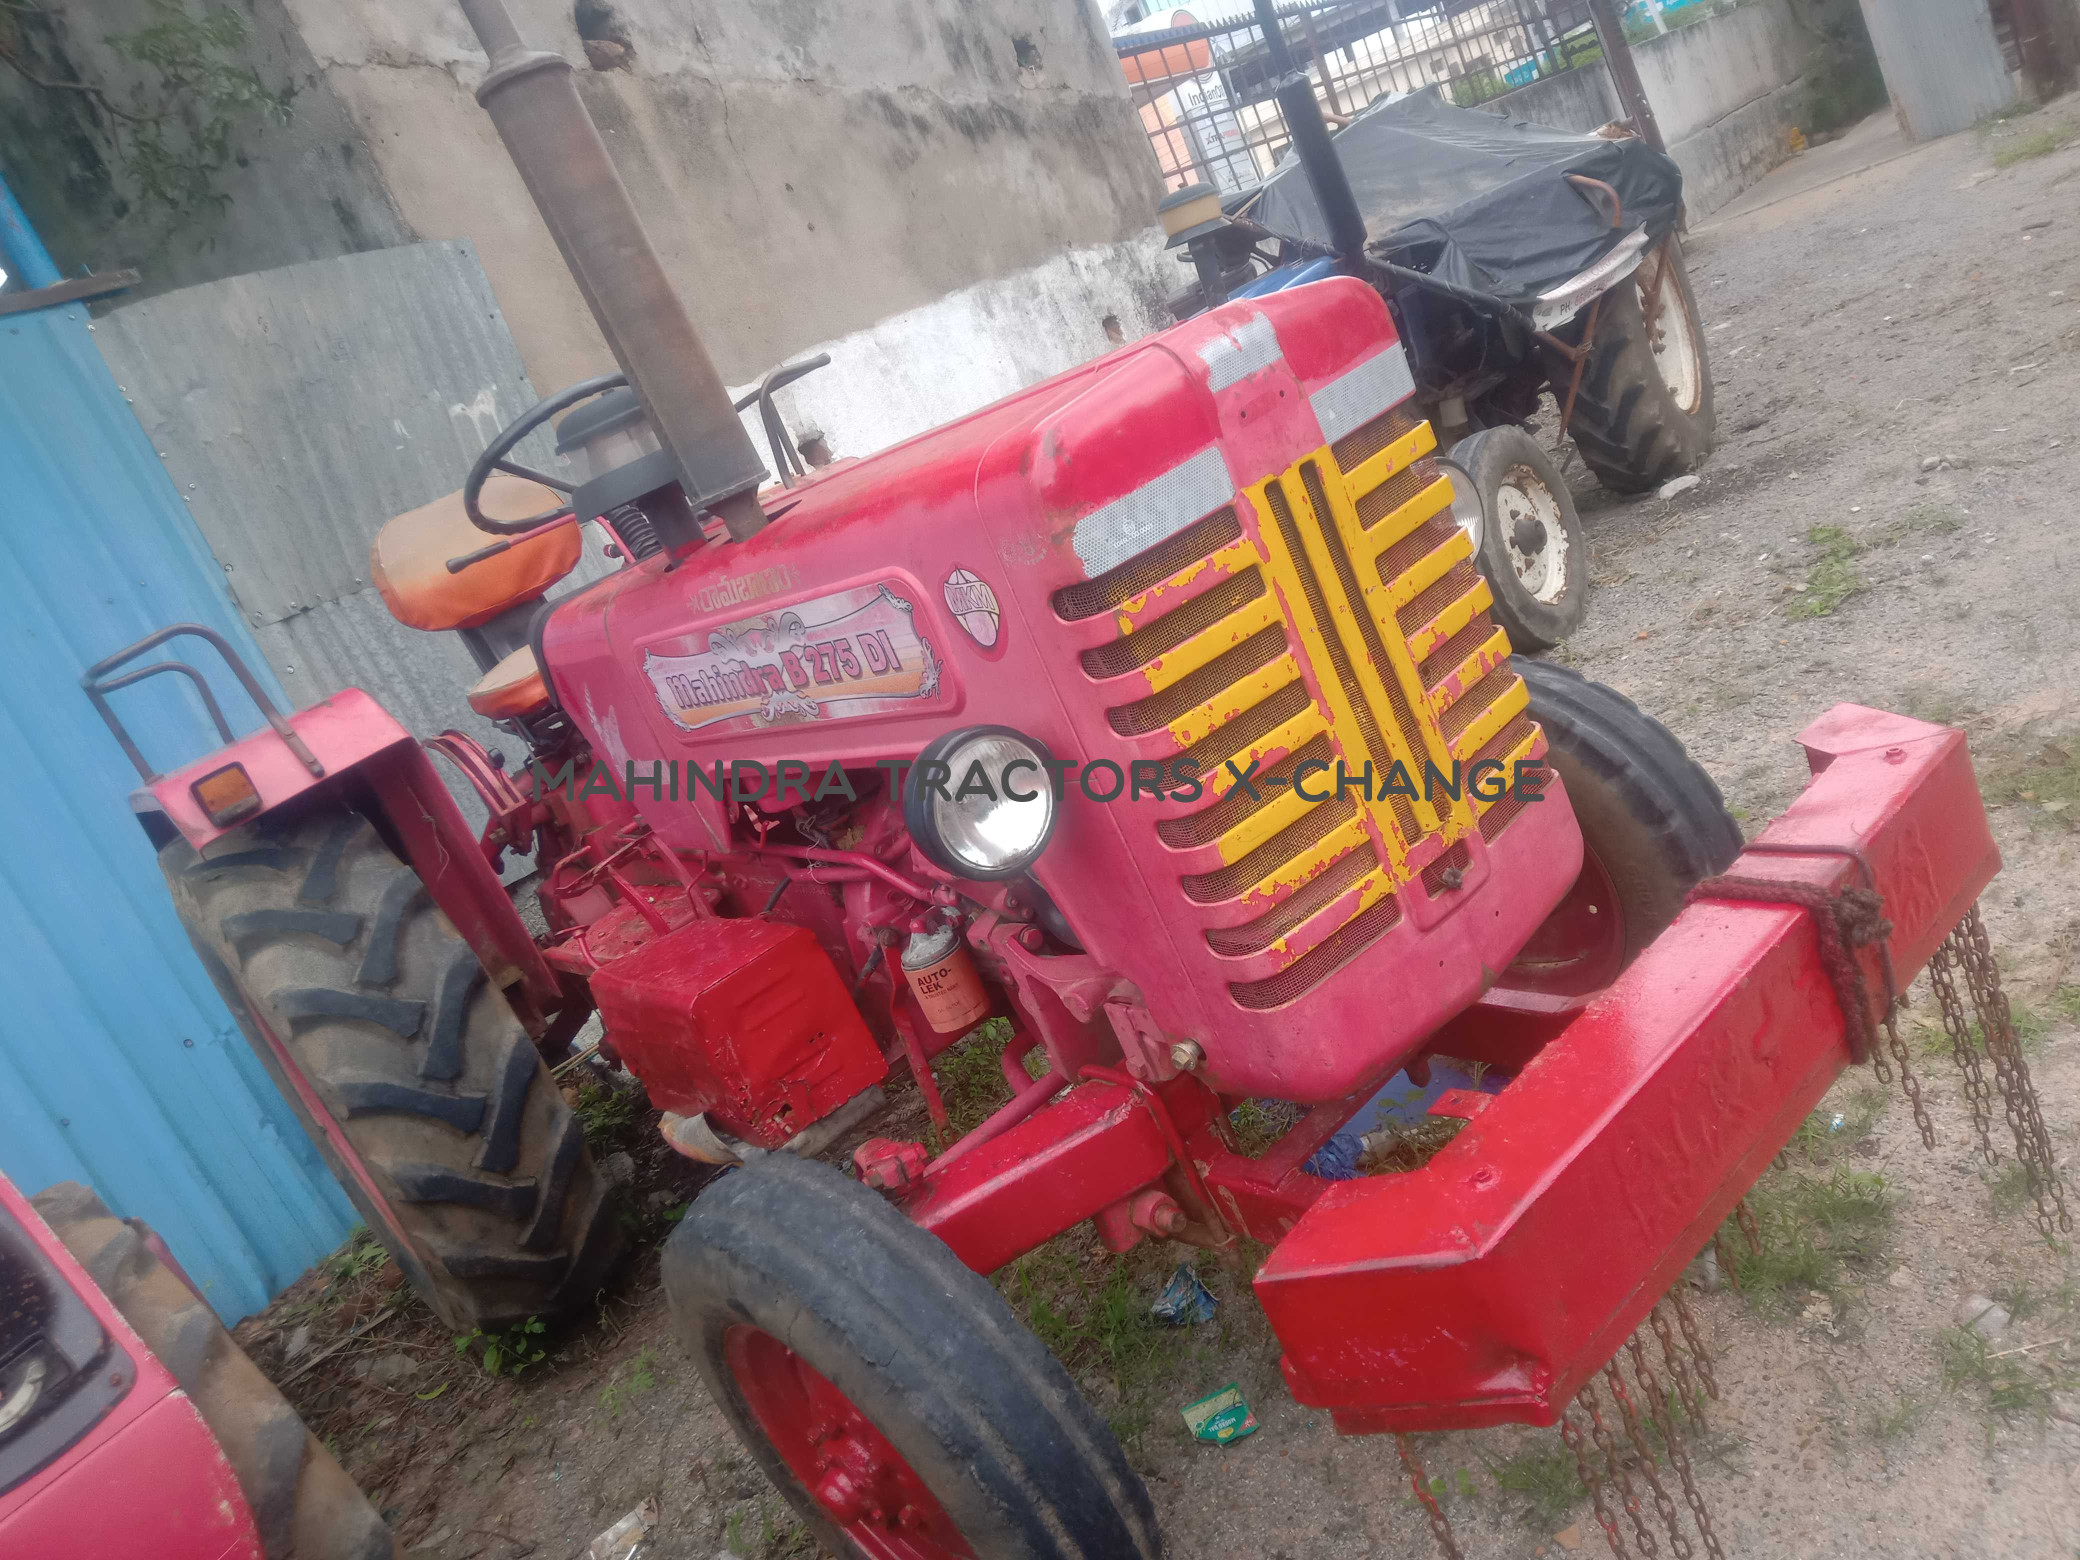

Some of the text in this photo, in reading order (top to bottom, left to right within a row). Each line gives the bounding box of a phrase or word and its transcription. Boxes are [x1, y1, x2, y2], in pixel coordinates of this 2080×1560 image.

[949, 582, 996, 613] MKM
[666, 629, 904, 708] Mahindra B 275 DI
[917, 968, 952, 986] AUTO-
[920, 981, 943, 994] LEK
